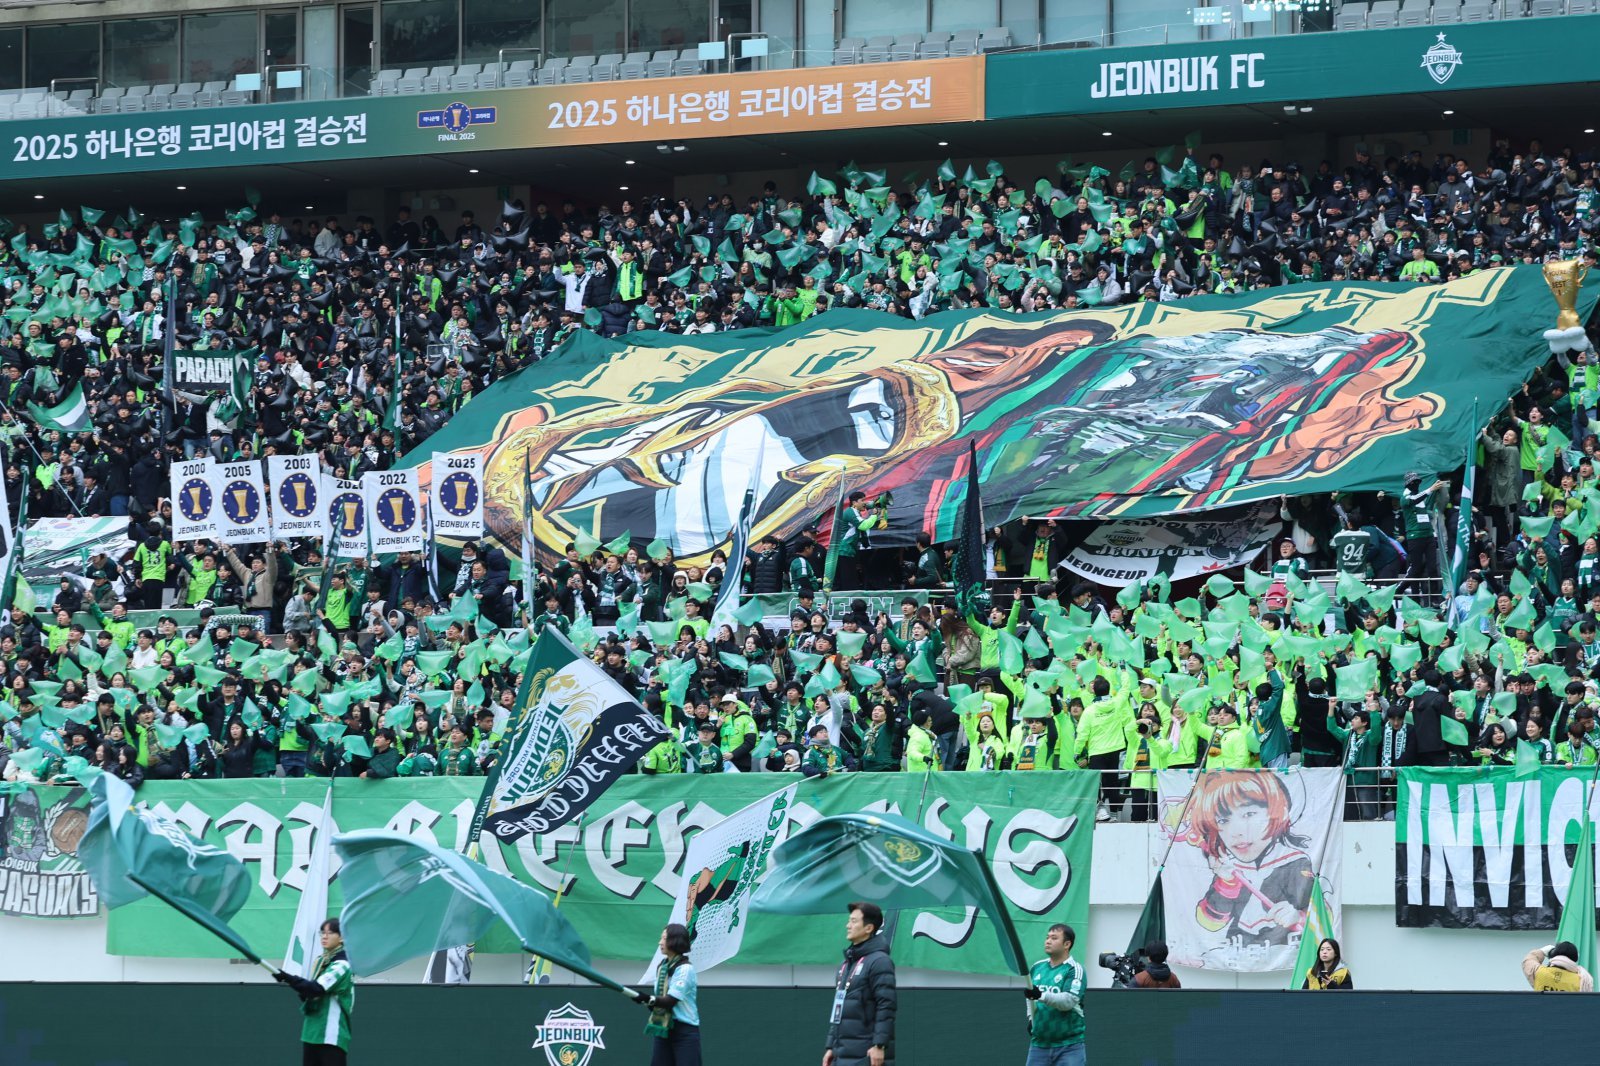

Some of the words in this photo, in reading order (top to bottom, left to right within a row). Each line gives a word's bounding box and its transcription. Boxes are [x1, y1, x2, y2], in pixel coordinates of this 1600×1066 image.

[1422, 54, 1460, 65] JEONBUK
[1090, 55, 1218, 99] JEONBUK
[1231, 52, 1265, 88] FC
[548, 99, 617, 129] 2025
[625, 92, 730, 126] 하나은행
[737, 82, 844, 119] 코리아컵
[852, 76, 931, 111] 결승전
[13, 134, 78, 162] 2025
[84, 124, 181, 160] 하나은행
[188, 117, 286, 153] 코리아컵
[294, 112, 367, 147] 결승전
[460, 132, 475, 140] 2025
[182, 463, 206, 476] 2000
[284, 458, 311, 471] 2003
[447, 457, 476, 469] 2025
[224, 465, 252, 478] 2005
[379, 473, 407, 486] 2022
[178, 525, 208, 535] JEONBUK
[278, 521, 311, 530] JEONBUK
[313, 520, 322, 529] FC
[435, 521, 468, 529] JEONBUK
[470, 521, 481, 529] FC
[225, 529, 256, 537] JEONBUK
[376, 536, 410, 546] JEONBUK
[412, 535, 421, 544] FC
[1343, 543, 1364, 561] 94
[1066, 554, 1148, 580] JEONGEUP
[540, 1027, 602, 1043] JEONBUK
